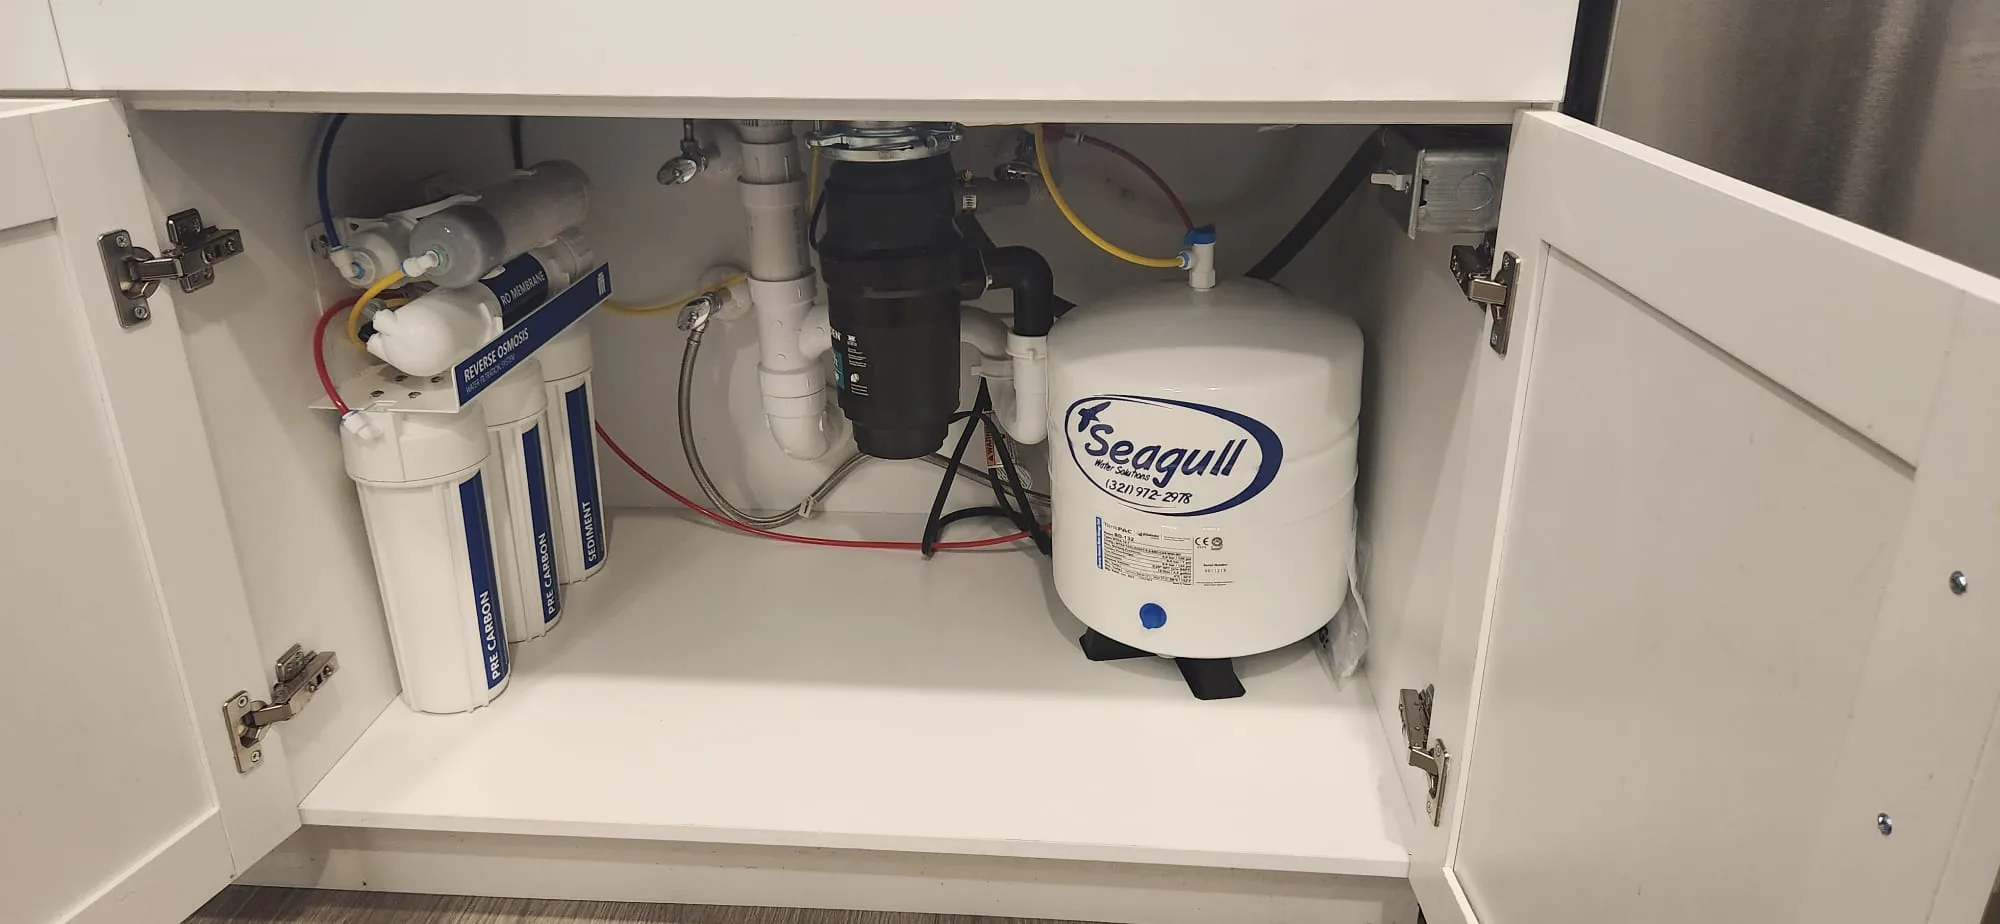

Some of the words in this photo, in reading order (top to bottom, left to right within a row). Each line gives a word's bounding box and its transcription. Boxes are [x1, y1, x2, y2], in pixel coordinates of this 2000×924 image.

[500, 292, 512, 307] RO
[511, 271, 546, 299] MEMBRANE
[463, 351, 497, 383] REVERSE
[497, 327, 529, 358] OSMOSIS
[466, 378, 479, 393] WATER
[479, 363, 500, 384] FILTRATION
[1084, 424, 1248, 488] Seagull
[1094, 458, 1114, 472] Water
[1115, 466, 1150, 481] Solutions
[1105, 479, 1134, 495] (321)
[1136, 486, 1193, 504] 972-2978
[582, 501, 597, 562] SEDIMENT
[538, 532, 552, 587] CARBON
[479, 590, 497, 651] CARBON
[546, 590, 556, 615] PRE
[489, 651, 501, 680] PRE
